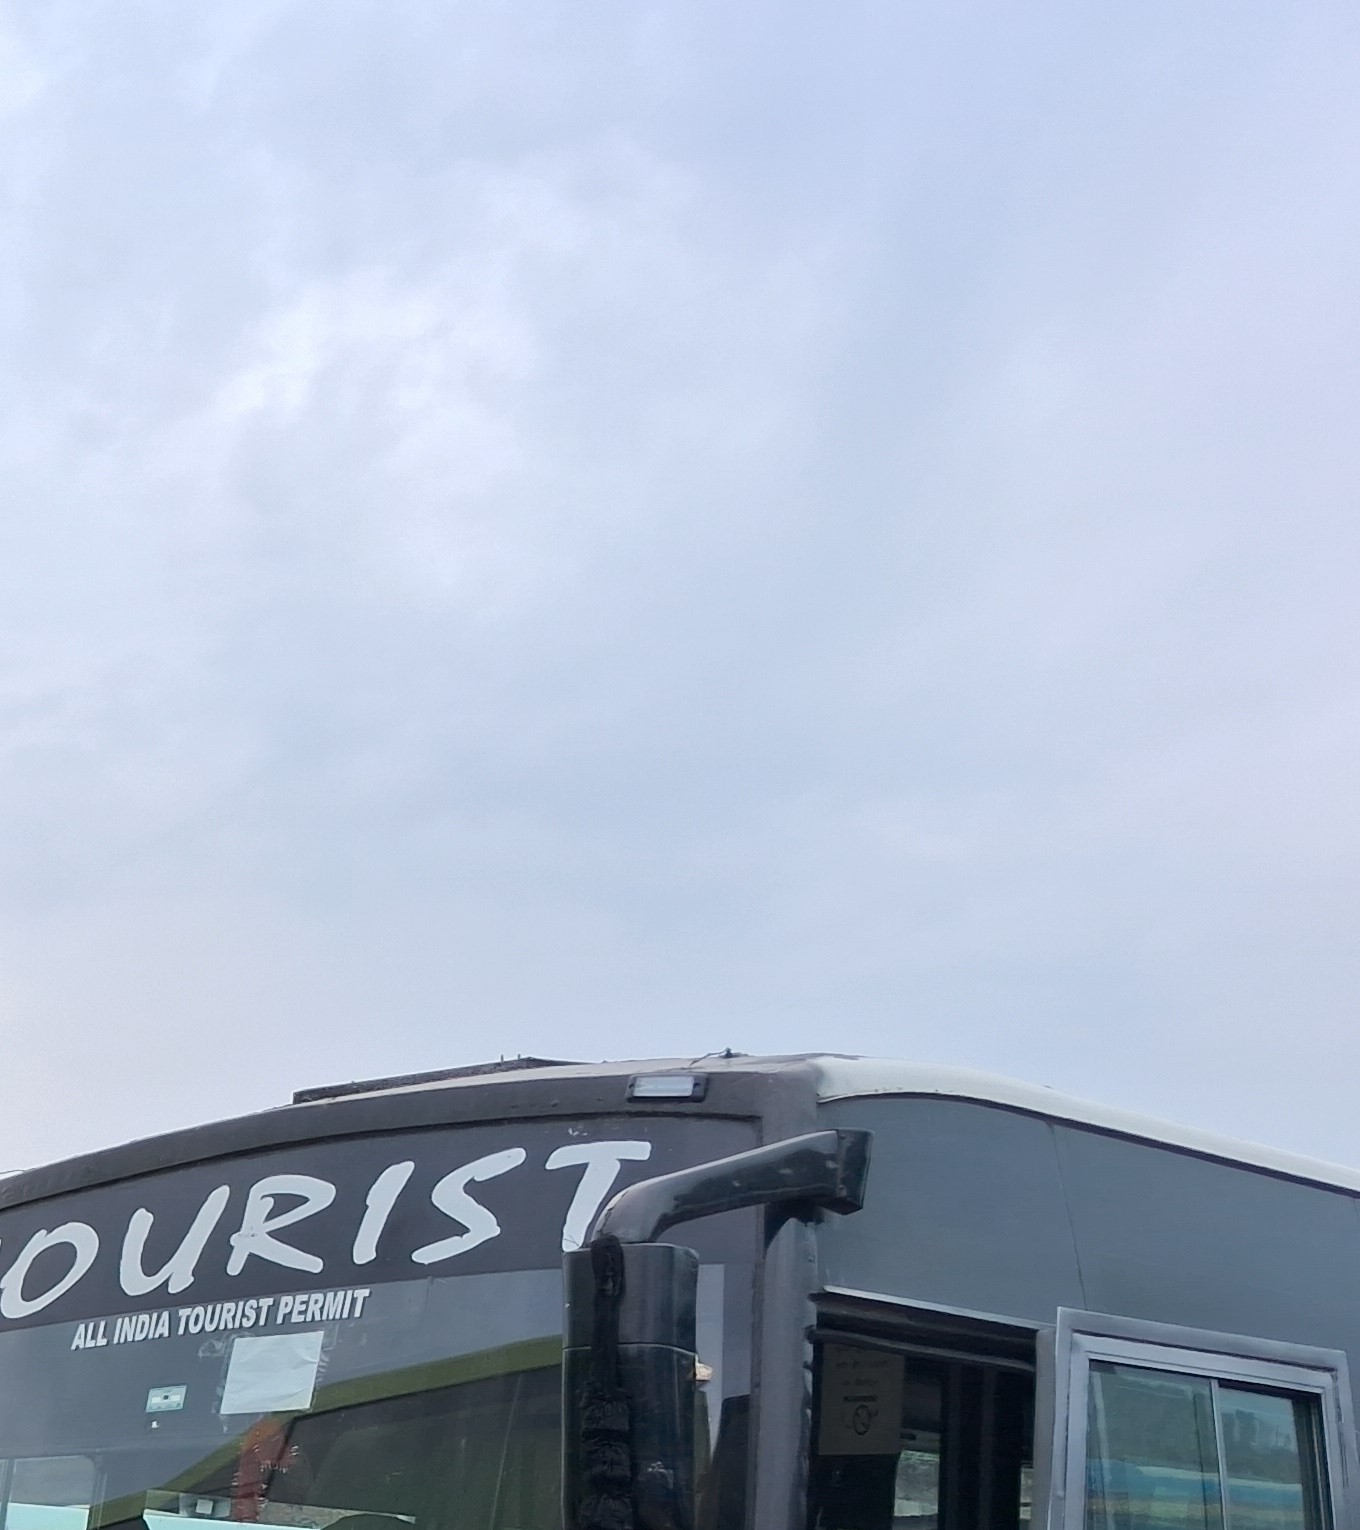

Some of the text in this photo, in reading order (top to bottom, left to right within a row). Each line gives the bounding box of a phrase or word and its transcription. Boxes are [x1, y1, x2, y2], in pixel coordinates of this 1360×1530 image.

[70, 1288, 371, 1350] ALL INDIA TOURIST PERMIT
